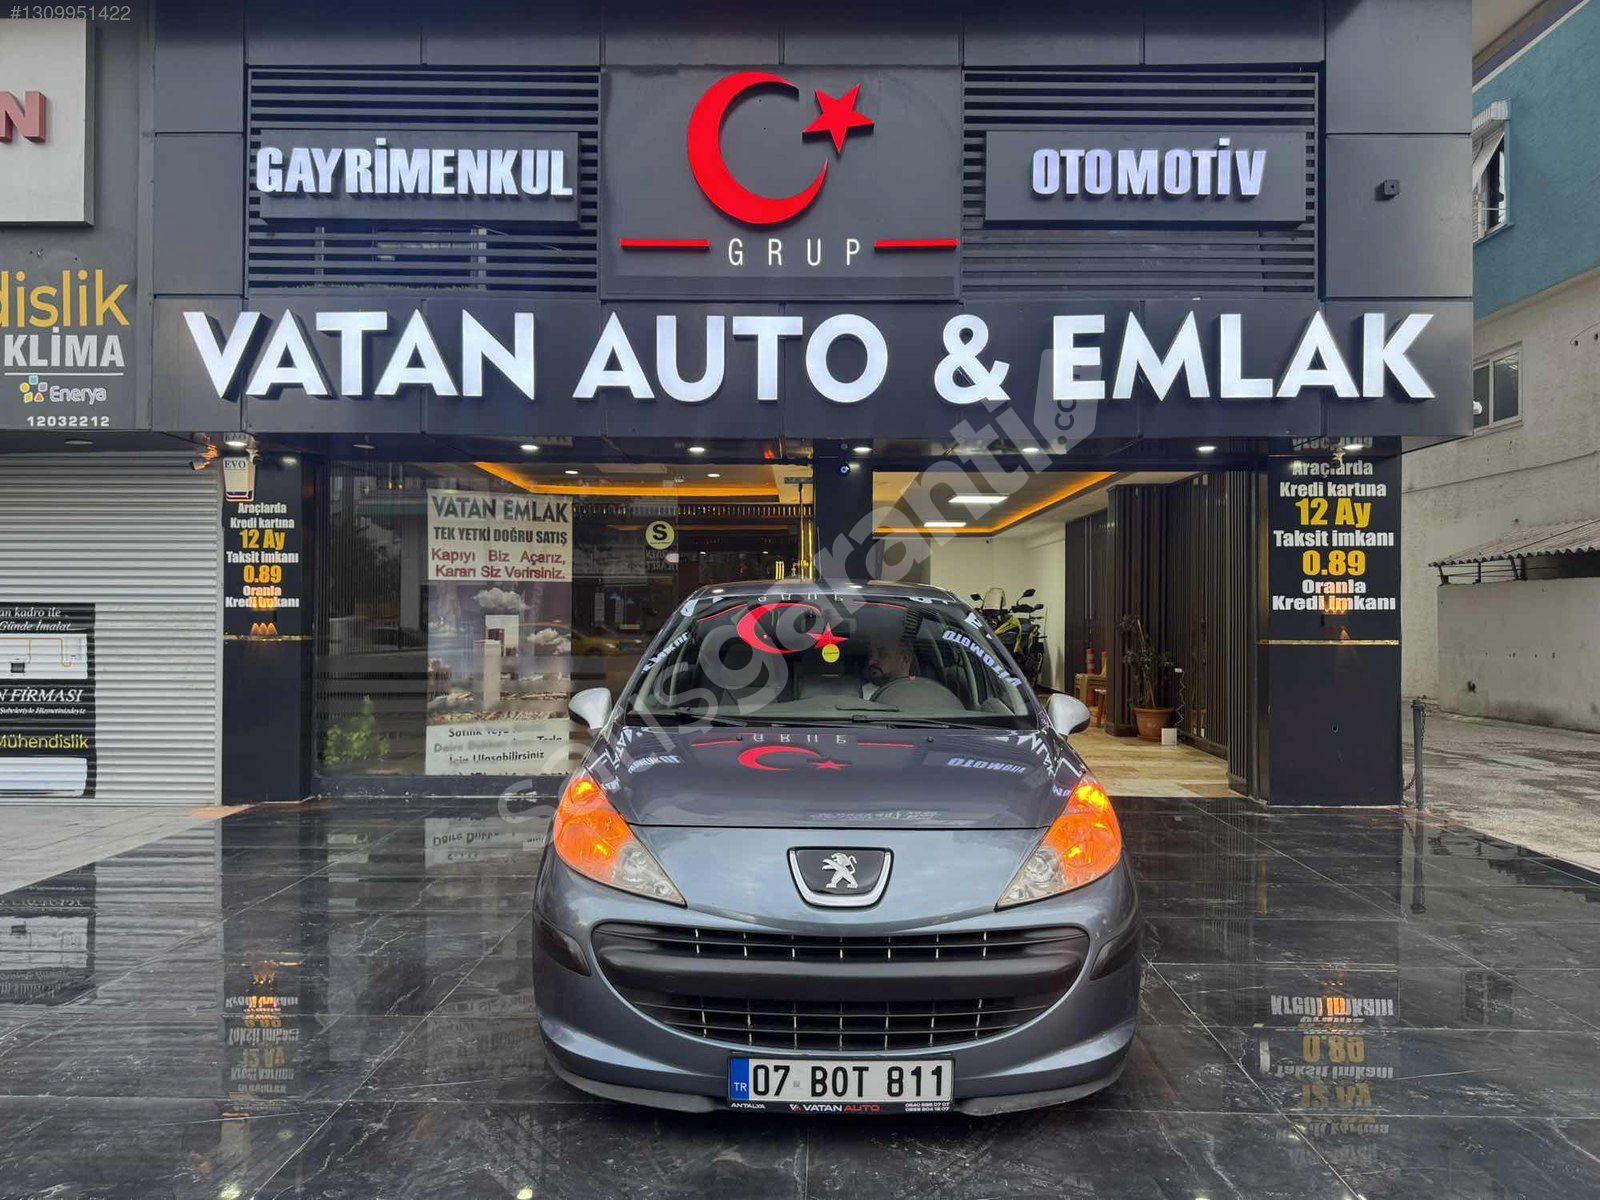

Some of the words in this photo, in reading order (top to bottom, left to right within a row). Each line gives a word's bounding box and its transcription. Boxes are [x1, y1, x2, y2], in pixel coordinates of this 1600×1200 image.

[256, 137, 573, 196] GAYRİMENKUL
[1032, 137, 1267, 196] OTOMOTİV
[728, 238, 860, 266] GRUP
[4, 327, 125, 367] KLİMA
[183, 309, 535, 400] VATAN
[572, 312, 888, 404] AUTO
[934, 314, 1011, 404] &
[1052, 310, 1435, 400] EMLAK
[50, 385, 107, 405] Enerya
[27, 416, 110, 427] 12032212
[1280, 482, 1324, 497] Kredi
[1327, 482, 1386, 497] kartına
[238, 502, 287, 516] Araçlarda
[432, 496, 496, 518] VATAN
[504, 500, 568, 523] EMLAK
[1296, 498, 1328, 526] 12
[1335, 498, 1371, 528] Ay
[230, 517, 257, 529] Kredi
[239, 529, 259, 549] 12
[263, 529, 285, 550] Ay
[434, 527, 455, 540] TEK
[458, 526, 490, 541] YETKİ
[494, 527, 534, 542] DOĞRU
[536, 531, 567, 544] SATIŞ
[652, 523, 668, 541] S
[1273, 530, 1329, 546] Taksit
[1332, 530, 1394, 546] imkanı
[226, 551, 260, 563] Taksit
[489, 550, 510, 562] Biz
[1302, 550, 1366, 576] 0.89
[243, 565, 282, 583] 0.89
[481, 566, 502, 578] Siz
[243, 585, 282, 596] Oranla
[1302, 579, 1366, 594] Oranla
[1272, 595, 1325, 611] Kredi
[14, 606, 45, 618] kadro
[10, 686, 83, 702] FİRMASI
[733, 1082, 747, 1091] TR
[753, 1064, 790, 1096] 07
[811, 1066, 869, 1097] BOT
[887, 1065, 943, 1097] 811
